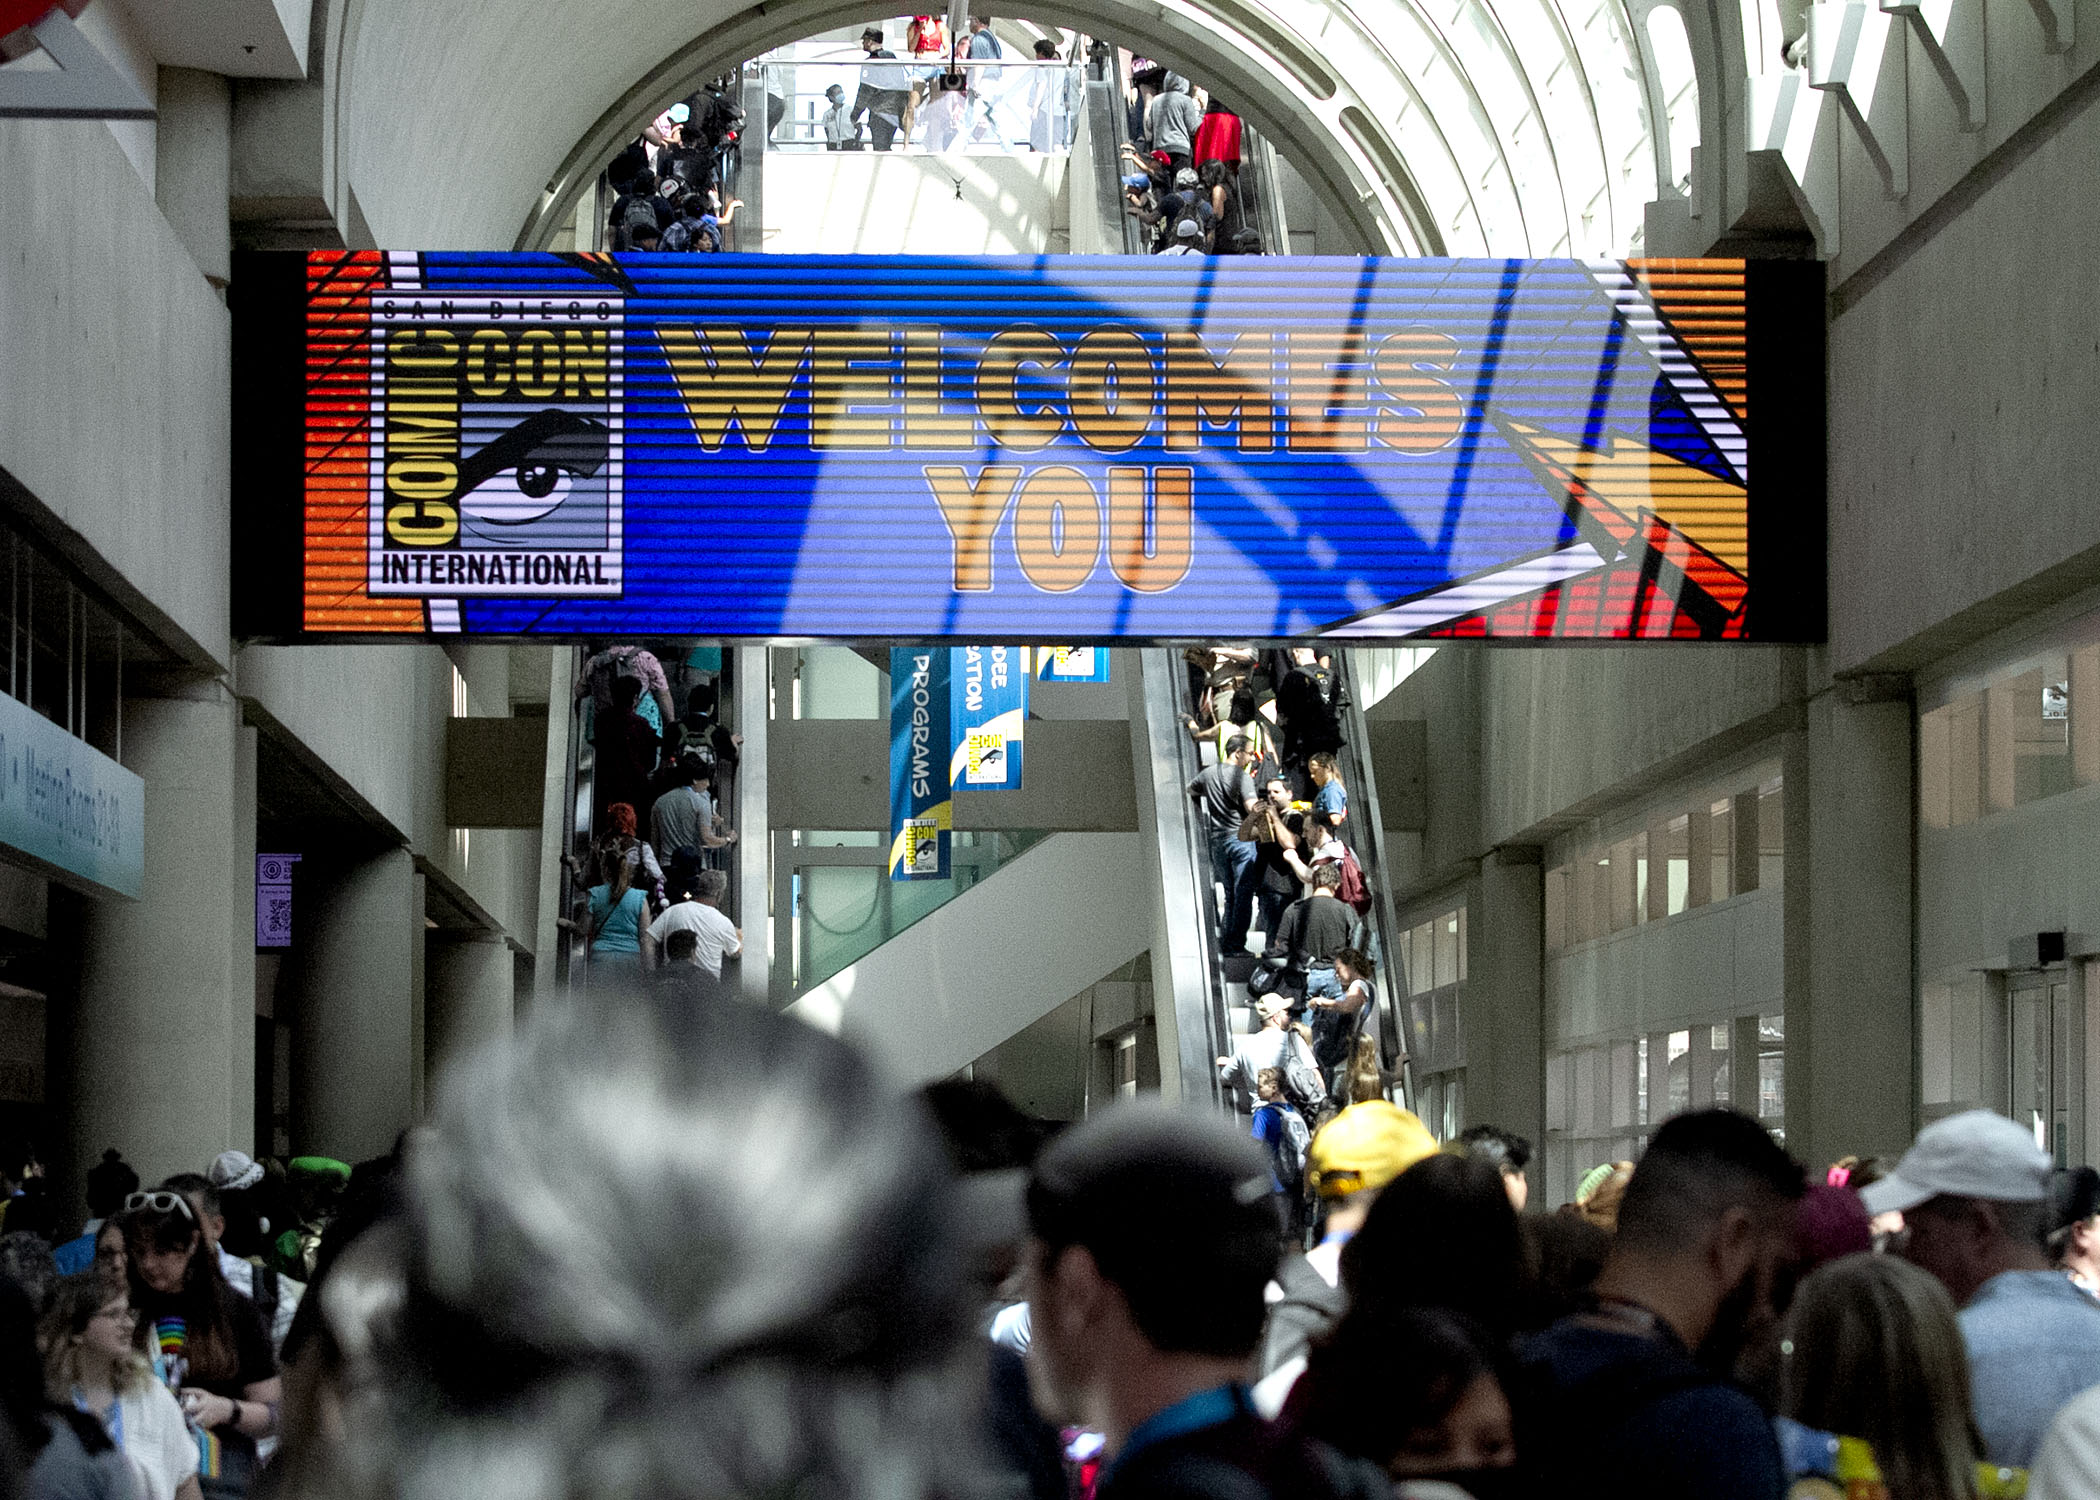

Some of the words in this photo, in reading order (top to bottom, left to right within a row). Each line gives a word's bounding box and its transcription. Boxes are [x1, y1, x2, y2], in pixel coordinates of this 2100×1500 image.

[383, 300, 453, 319] SAN
[490, 301, 610, 320] DIEGO
[466, 329, 607, 397] CON
[386, 329, 459, 546] COMIC
[654, 322, 1465, 453] WELCOMES
[382, 553, 609, 586] INTERNATIONAL
[923, 465, 1194, 593] YOU
[912, 655, 931, 798] PROGRAMS
